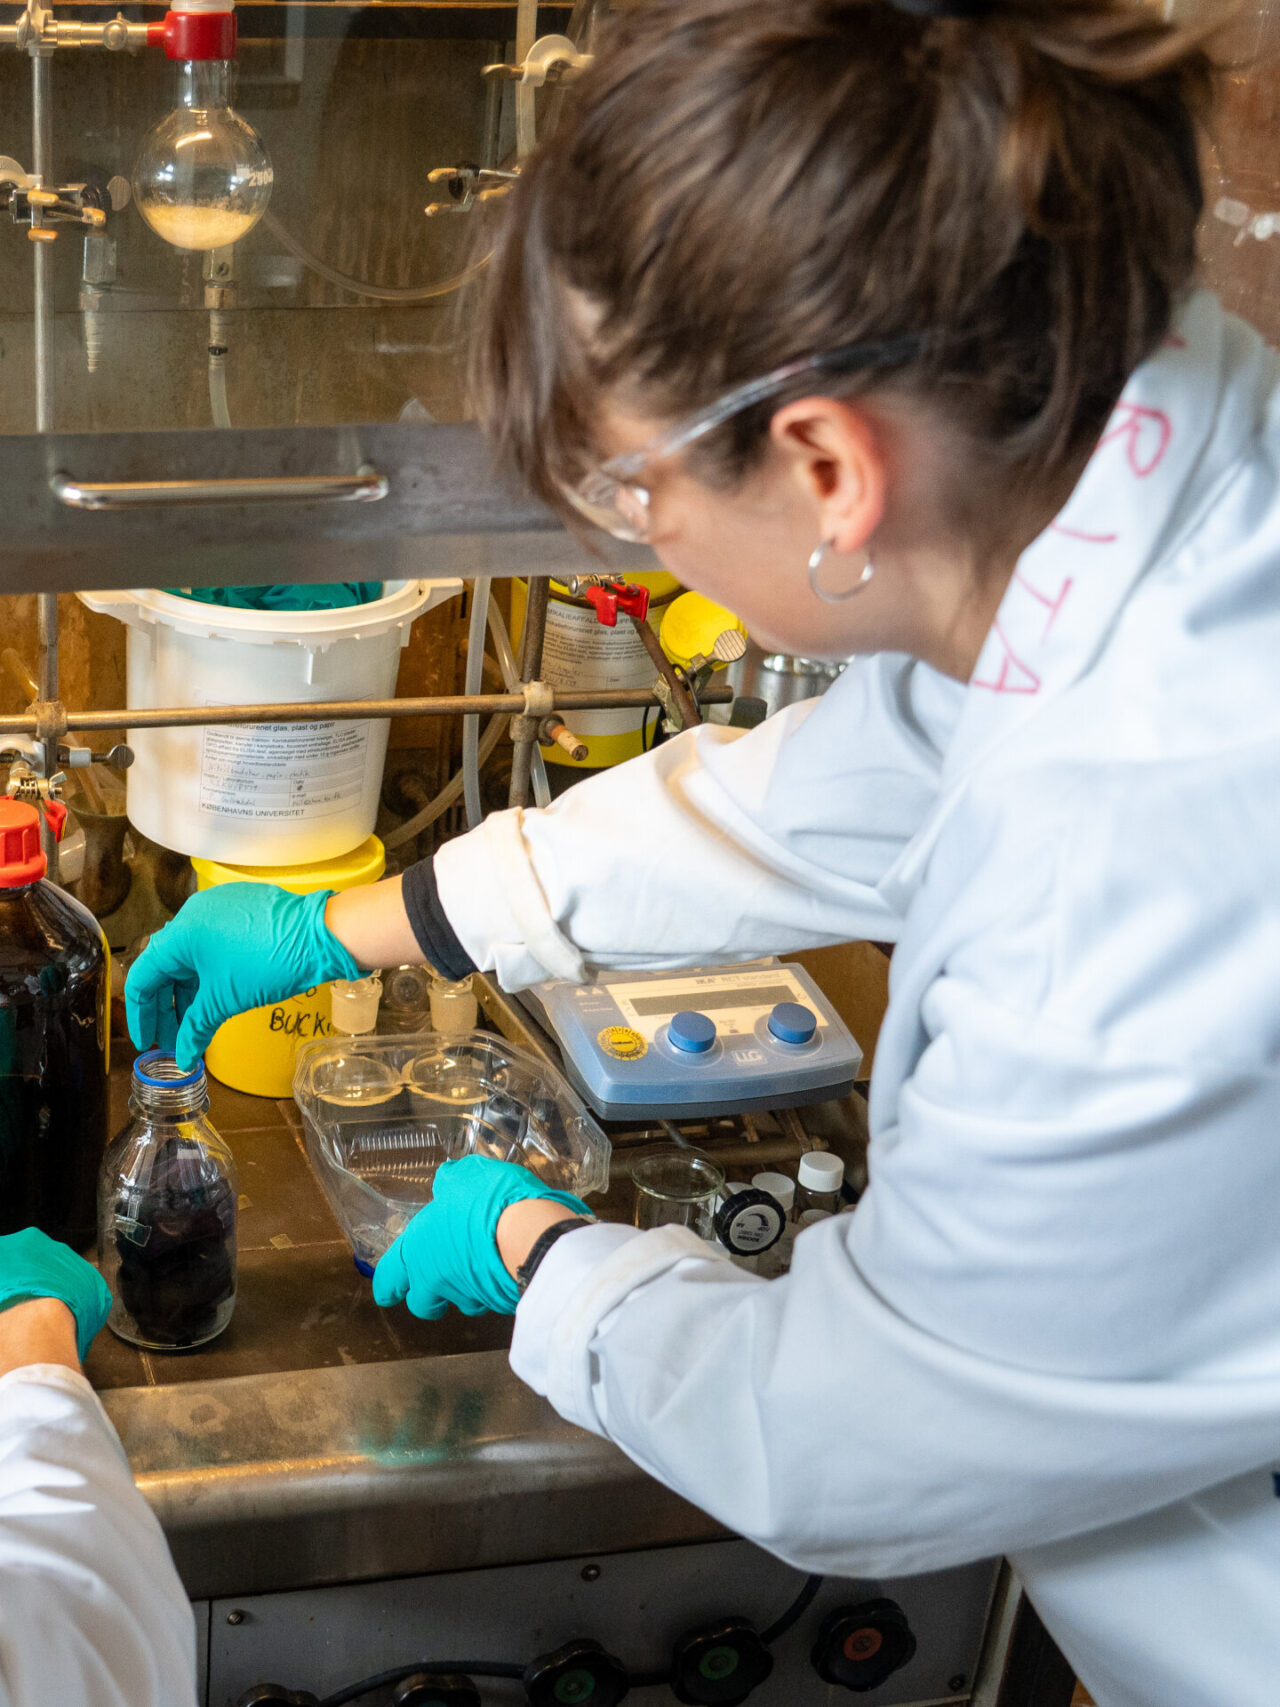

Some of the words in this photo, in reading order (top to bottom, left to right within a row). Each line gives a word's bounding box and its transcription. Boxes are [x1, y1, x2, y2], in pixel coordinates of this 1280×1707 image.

[291, 723, 309, 732] plast
[309, 723, 319, 731] og
[319, 721, 336, 731] papir
[201, 803, 254, 816] KØBENHAVNS
[255, 808, 305, 817] UNIVERSITET
[269, 1007, 331, 1037] BUCK
